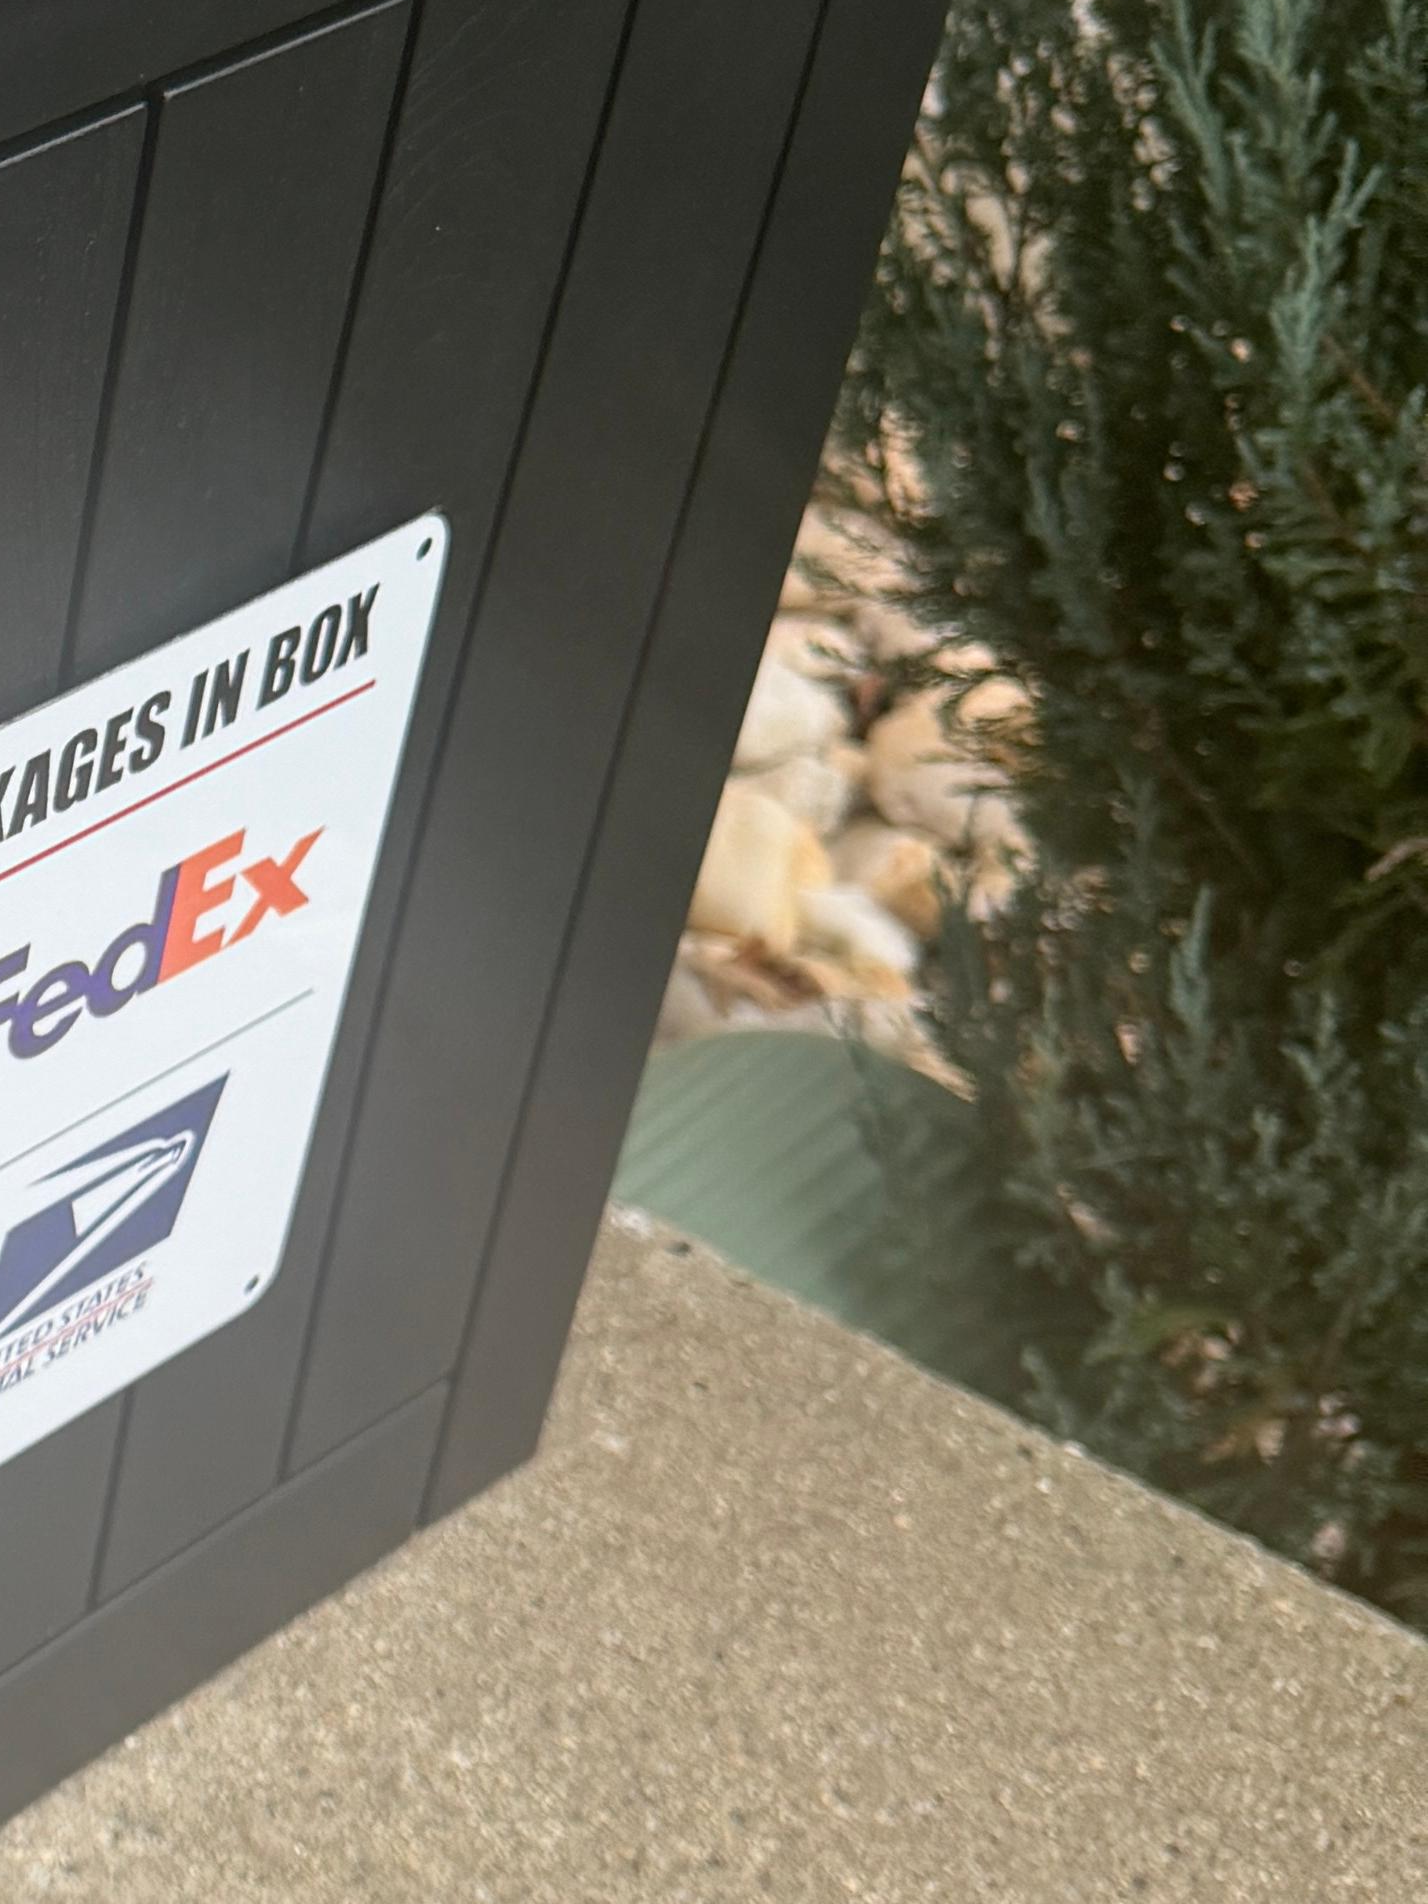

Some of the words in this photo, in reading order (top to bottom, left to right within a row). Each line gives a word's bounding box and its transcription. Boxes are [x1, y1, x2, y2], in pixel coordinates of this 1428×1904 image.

[180, 648, 250, 750] IN
[255, 582, 380, 712] BOX
[43, 1289, 149, 1368] SERVICE
[60, 1260, 148, 1329] STATES
